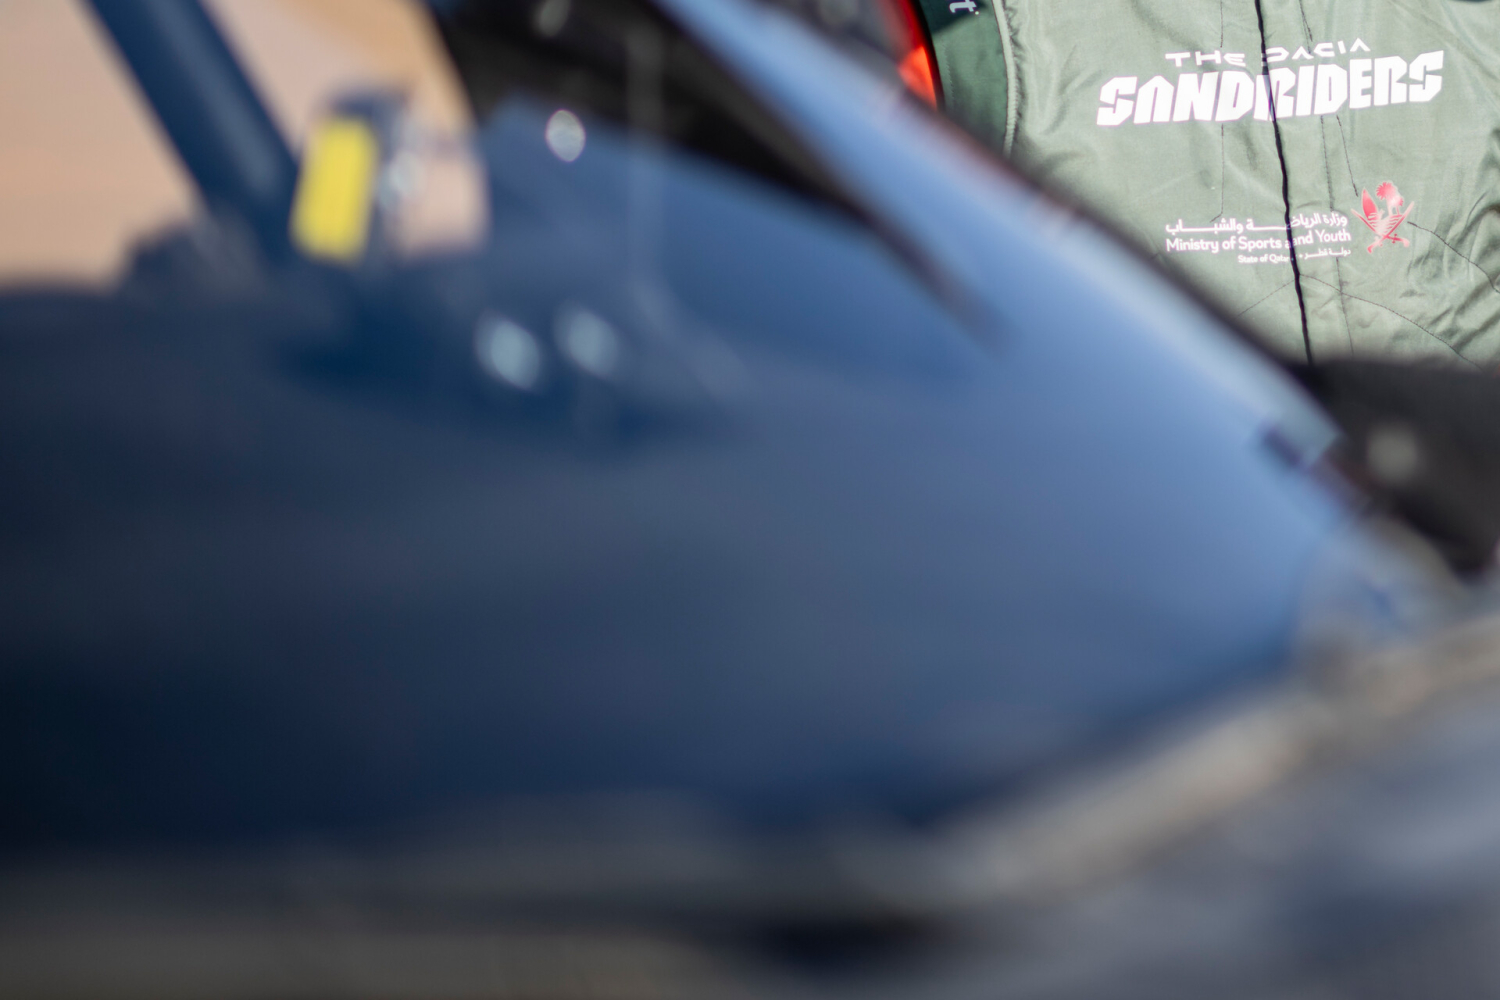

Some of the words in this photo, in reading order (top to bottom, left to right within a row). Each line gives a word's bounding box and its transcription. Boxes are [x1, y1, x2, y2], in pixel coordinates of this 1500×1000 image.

[1164, 49, 1247, 68] THE
[1261, 37, 1371, 63] DACIA
[1096, 50, 1444, 126] SANDRIDERS
[1165, 217, 1245, 236] والشباب
[1320, 211, 1349, 228] وزارة
[1165, 237, 1219, 254] Ministry
[1221, 235, 1237, 250] of
[1238, 235, 1283, 253] Sports
[1314, 227, 1352, 243] Youth
[1237, 253, 1259, 264] State
[1259, 253, 1269, 263] of
